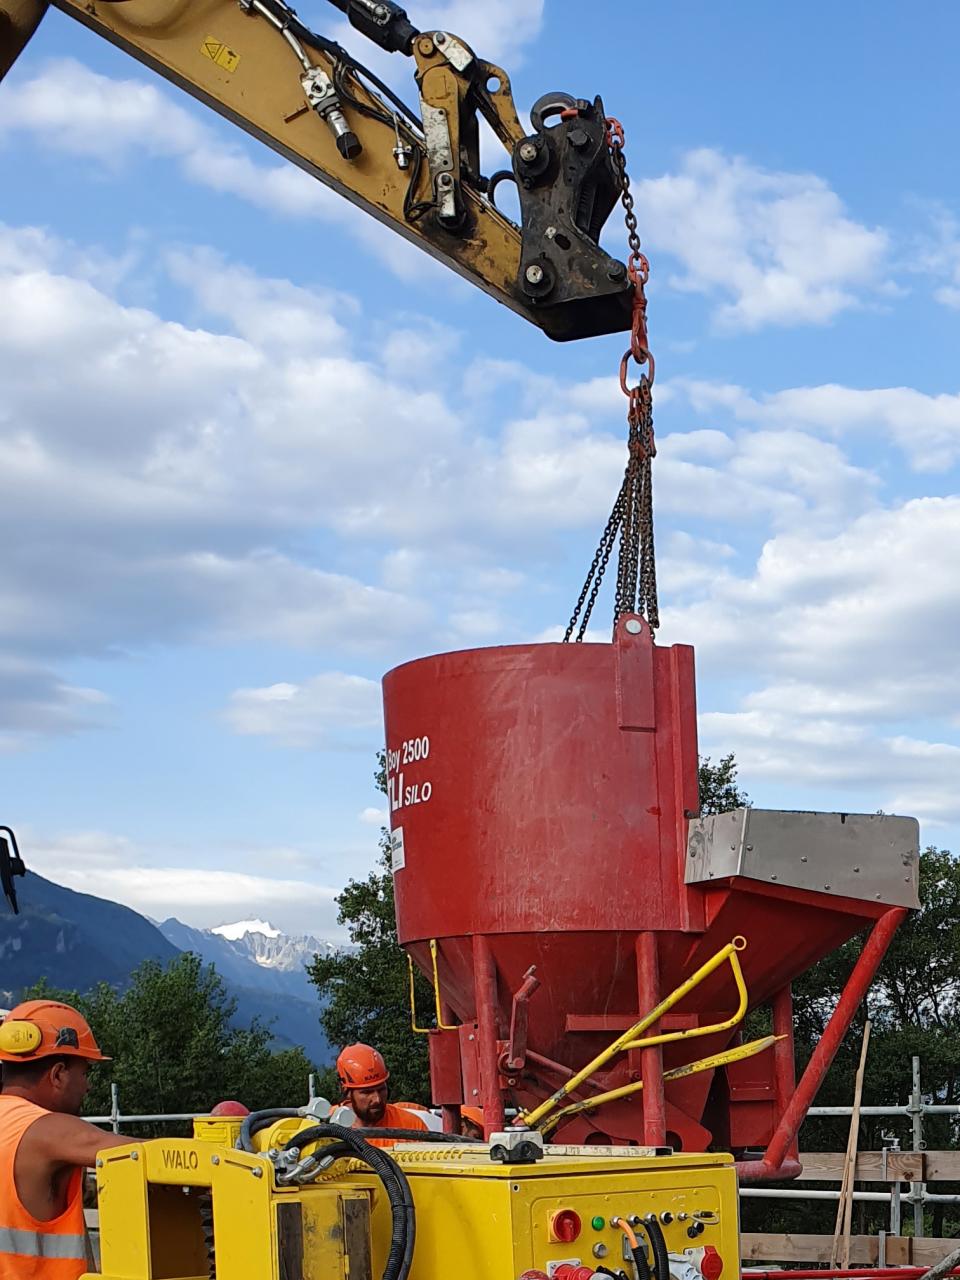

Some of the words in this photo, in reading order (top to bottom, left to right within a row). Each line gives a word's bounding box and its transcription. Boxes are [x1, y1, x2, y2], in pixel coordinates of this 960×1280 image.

[402, 736, 430, 764] 2500
[404, 782, 432, 806] SILO
[161, 1149, 199, 1170] WALO
